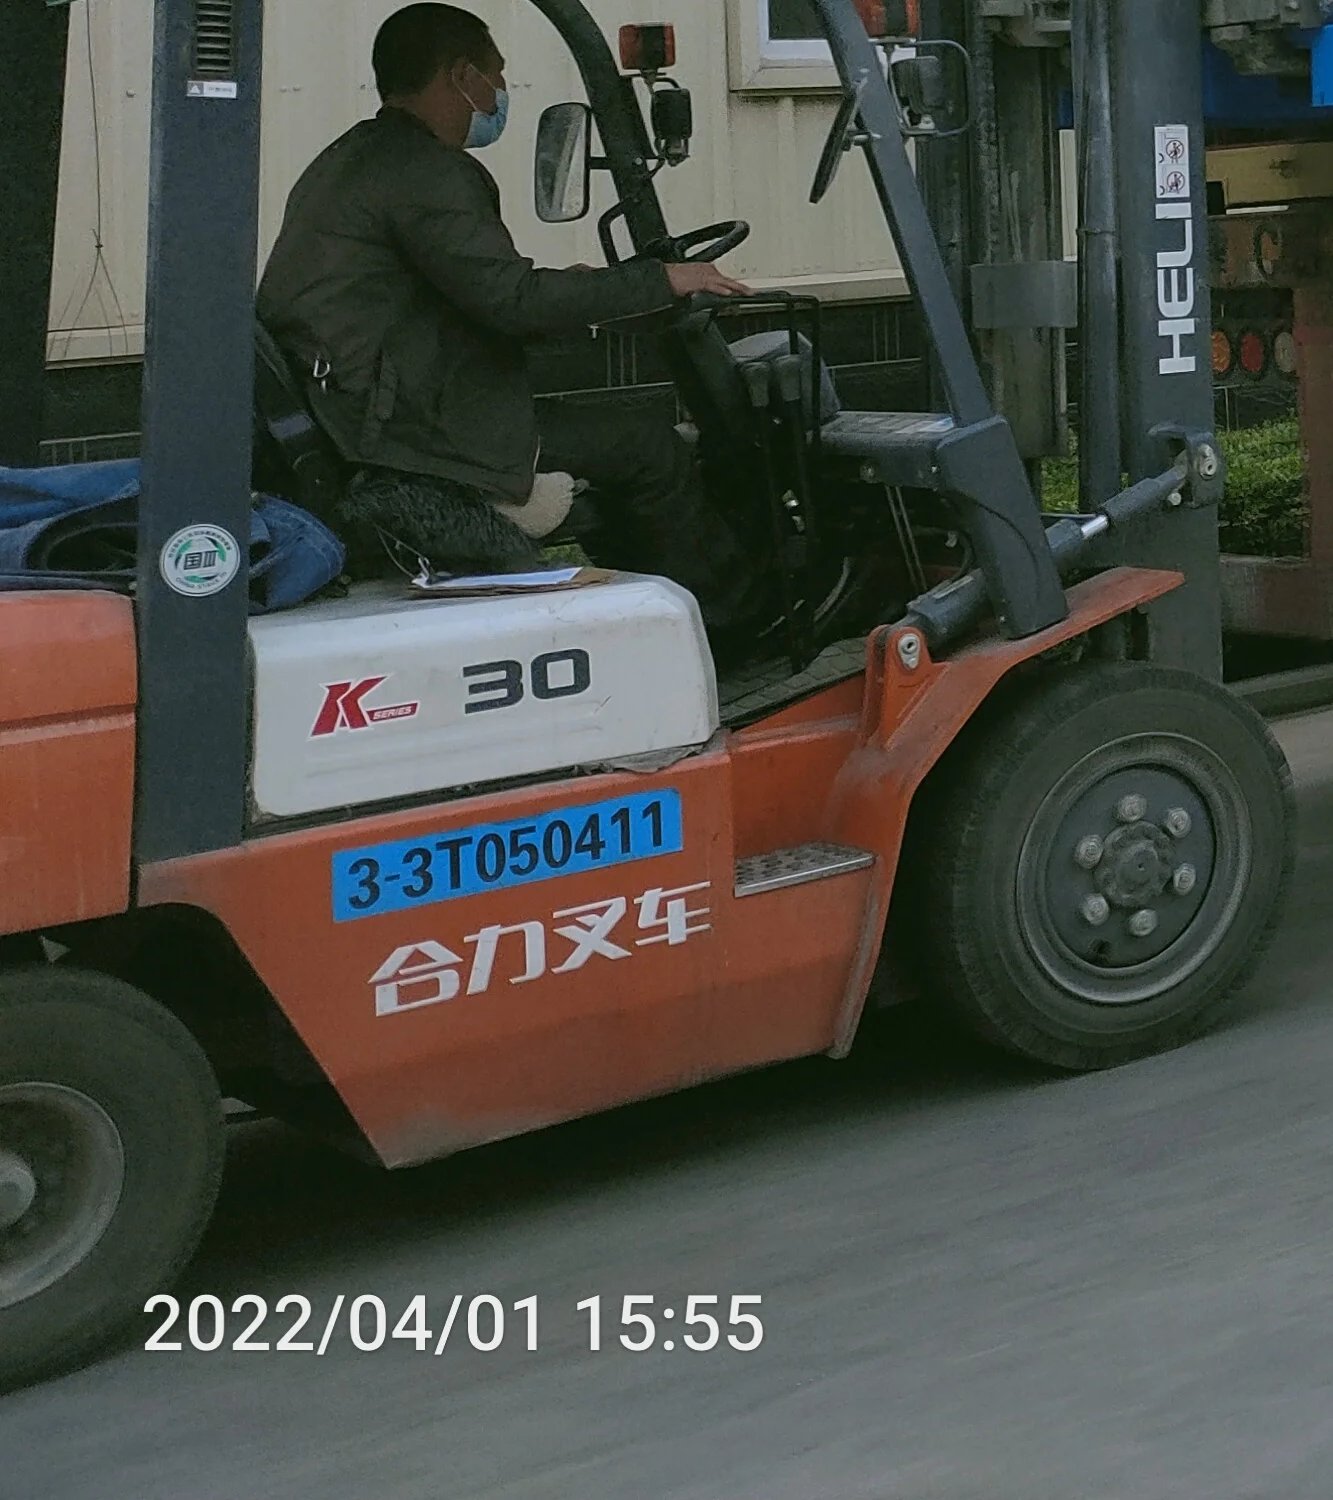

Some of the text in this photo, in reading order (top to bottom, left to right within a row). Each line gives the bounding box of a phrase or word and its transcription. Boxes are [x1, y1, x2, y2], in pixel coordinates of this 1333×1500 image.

[1155, 202, 1196, 375] HELI
[309, 674, 413, 738] K SERIES
[462, 648, 592, 715] 30
[348, 800, 663, 911] 3-3T050411
[367, 880, 712, 1017] 合力叉车
